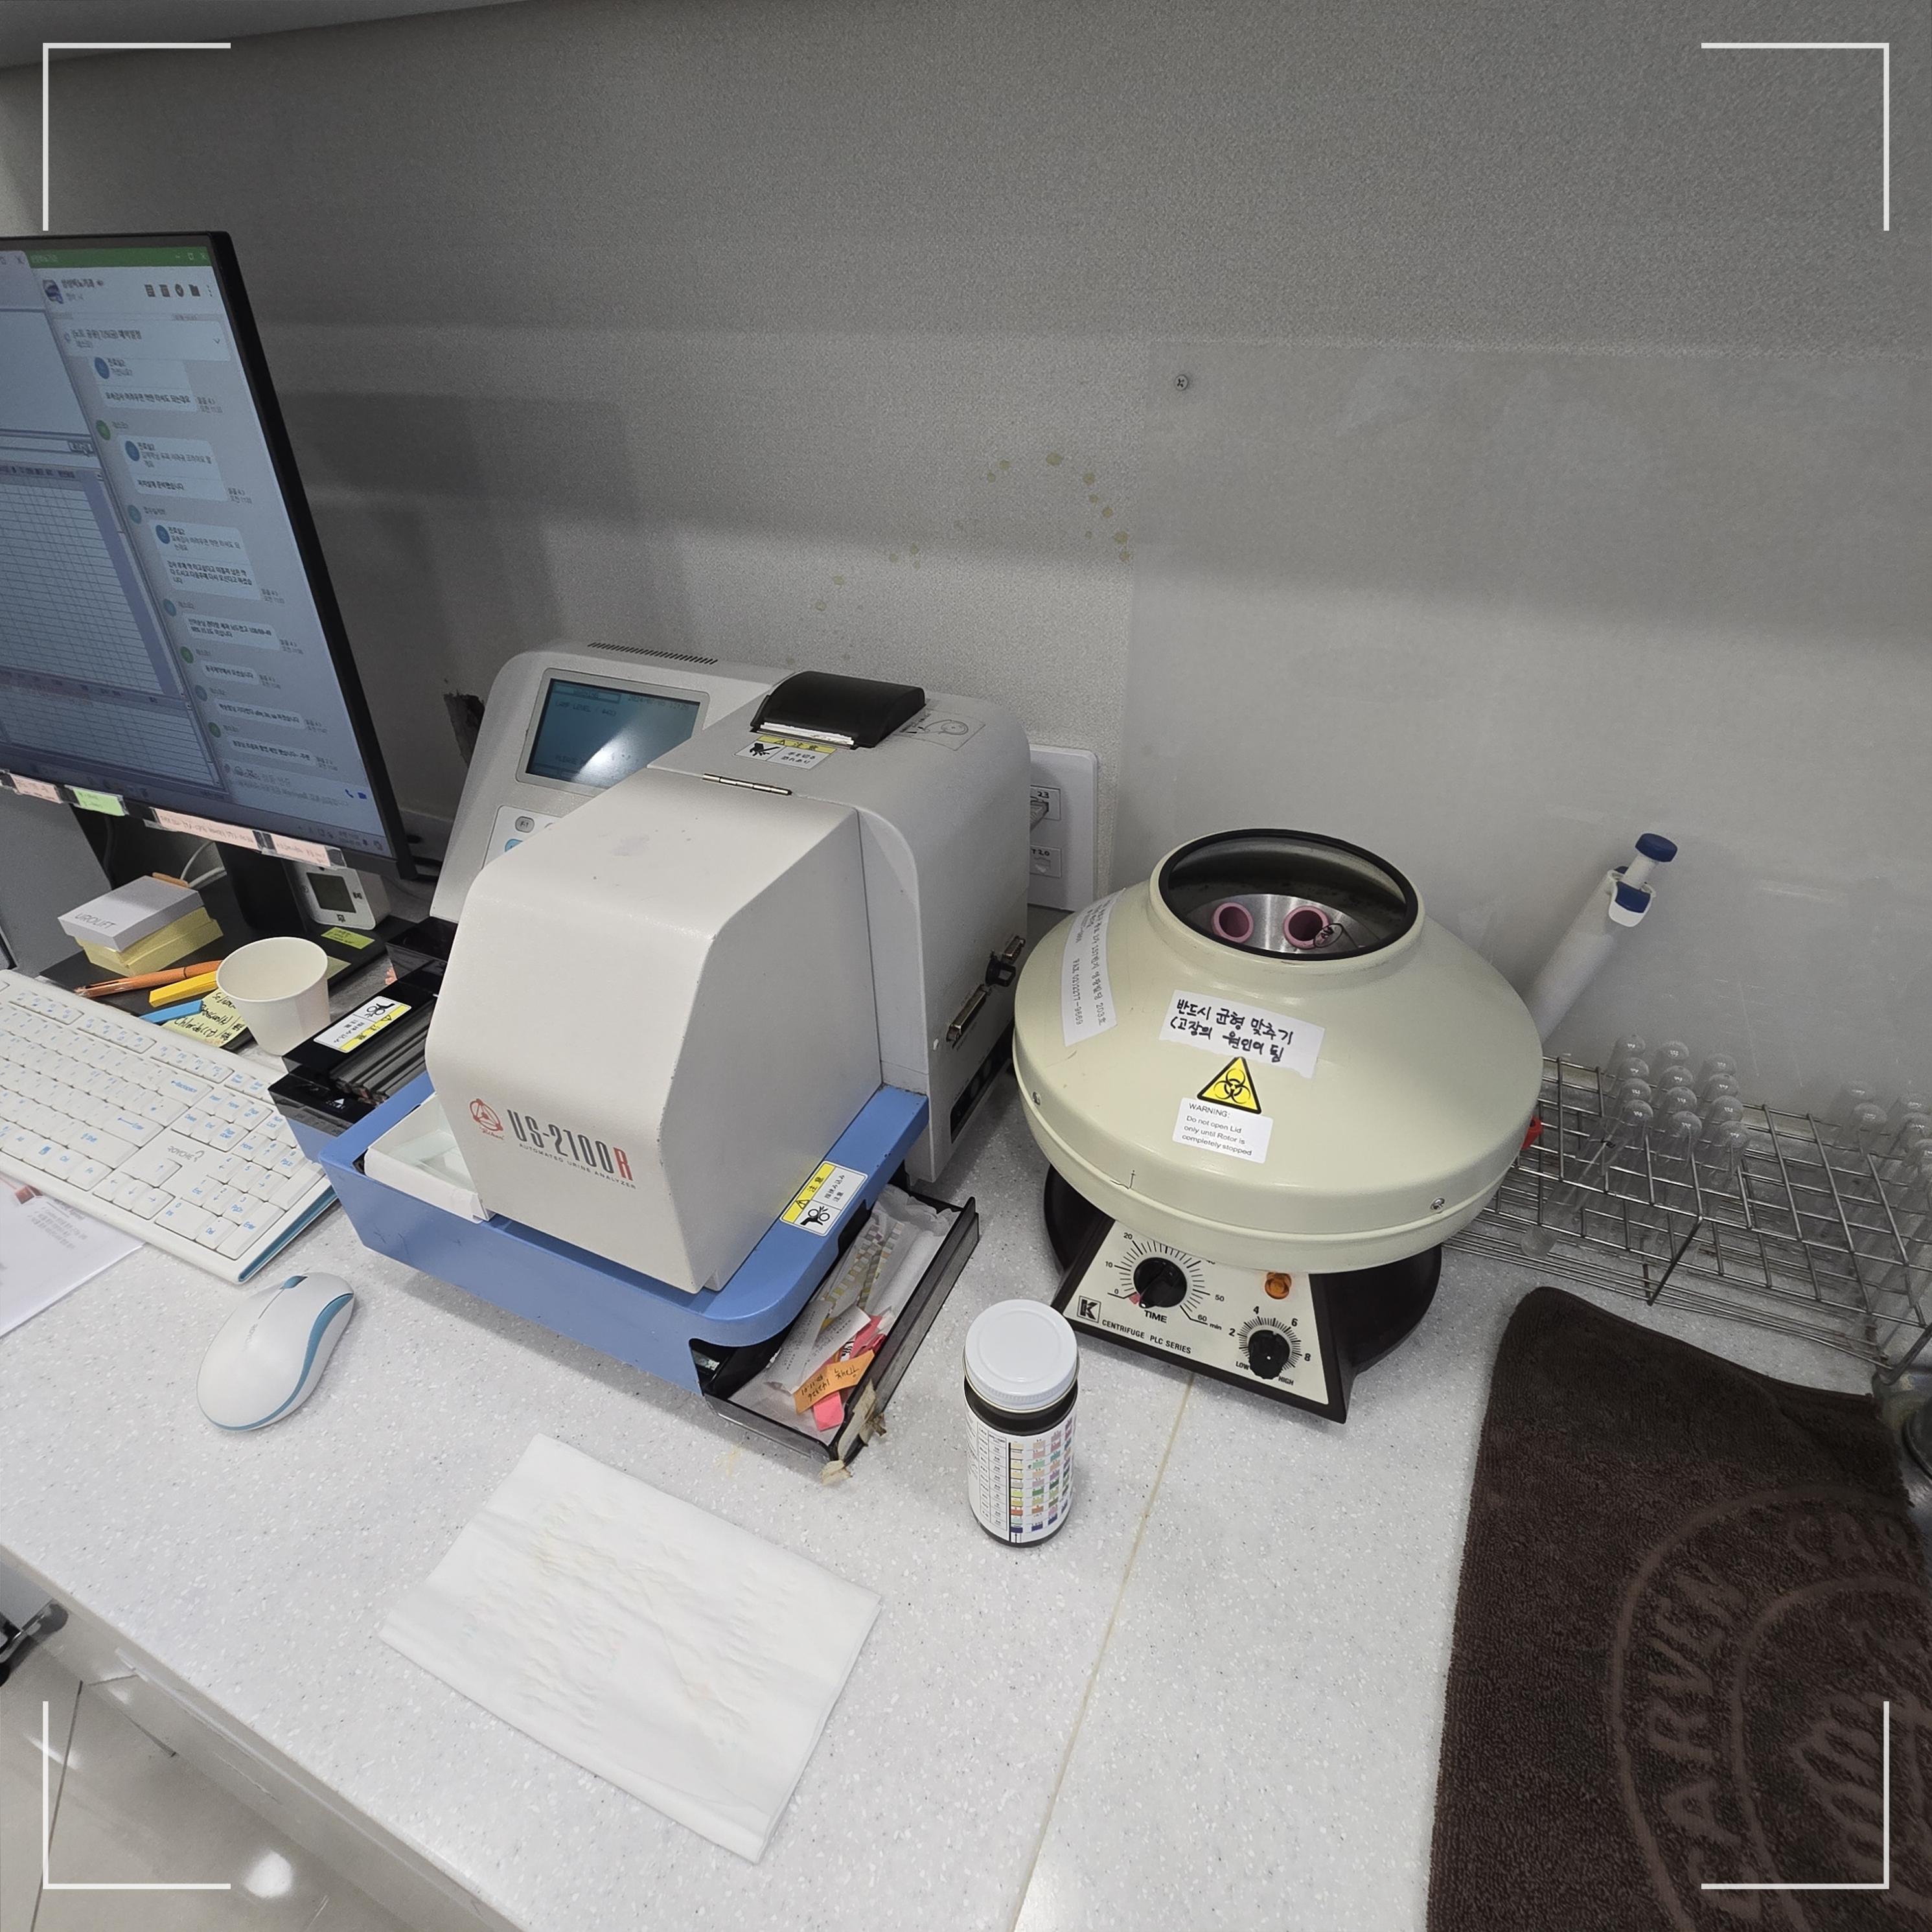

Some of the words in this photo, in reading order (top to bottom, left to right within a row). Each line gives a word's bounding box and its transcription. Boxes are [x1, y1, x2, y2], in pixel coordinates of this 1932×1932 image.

[75, 913, 116, 929] UROLIFT
[1169, 1015, 1213, 1040] (고장의
[1177, 998, 1212, 1021] 반드시
[1215, 1007, 1246, 1031] 균형
[1250, 1017, 1294, 1045] 맞추기
[1189, 1103, 1231, 1119] WARNING:
[1186, 1115, 1197, 1123] Do
[1198, 1118, 1210, 1127] not
[1211, 1121, 1228, 1132] open
[1230, 1125, 1243, 1134] Lid
[1184, 1125, 1199, 1134] only
[1200, 1127, 1216, 1138] until
[1217, 1132, 1237, 1142] Rotor
[1182, 1134, 1222, 1149] completely
[1222, 1143, 1252, 1156] stopped
[519, 1143, 564, 1163] AUTOMATED
[567, 1160, 592, 1173] URINE
[594, 1171, 636, 1190] ANALYZER
[1123, 1232, 1133, 1240] 20
[1214, 1294, 1225, 1302] 50
[1144, 1309, 1167, 1324] TIME
[1253, 1305, 1259, 1315] 4
[1209, 1322, 1222, 1331] min
[1291, 1318, 1298, 1327] 6
[1101, 1318, 1145, 1339] CENTRIFUGE
[1149, 1335, 1164, 1345] PLC
[1165, 1339, 1192, 1355] SERIES
[1228, 1328, 1236, 1337] 2
[1304, 1353, 1311, 1361] 8
[1236, 1361, 1250, 1370] LOW
[1278, 1375, 1294, 1386] HIGH
